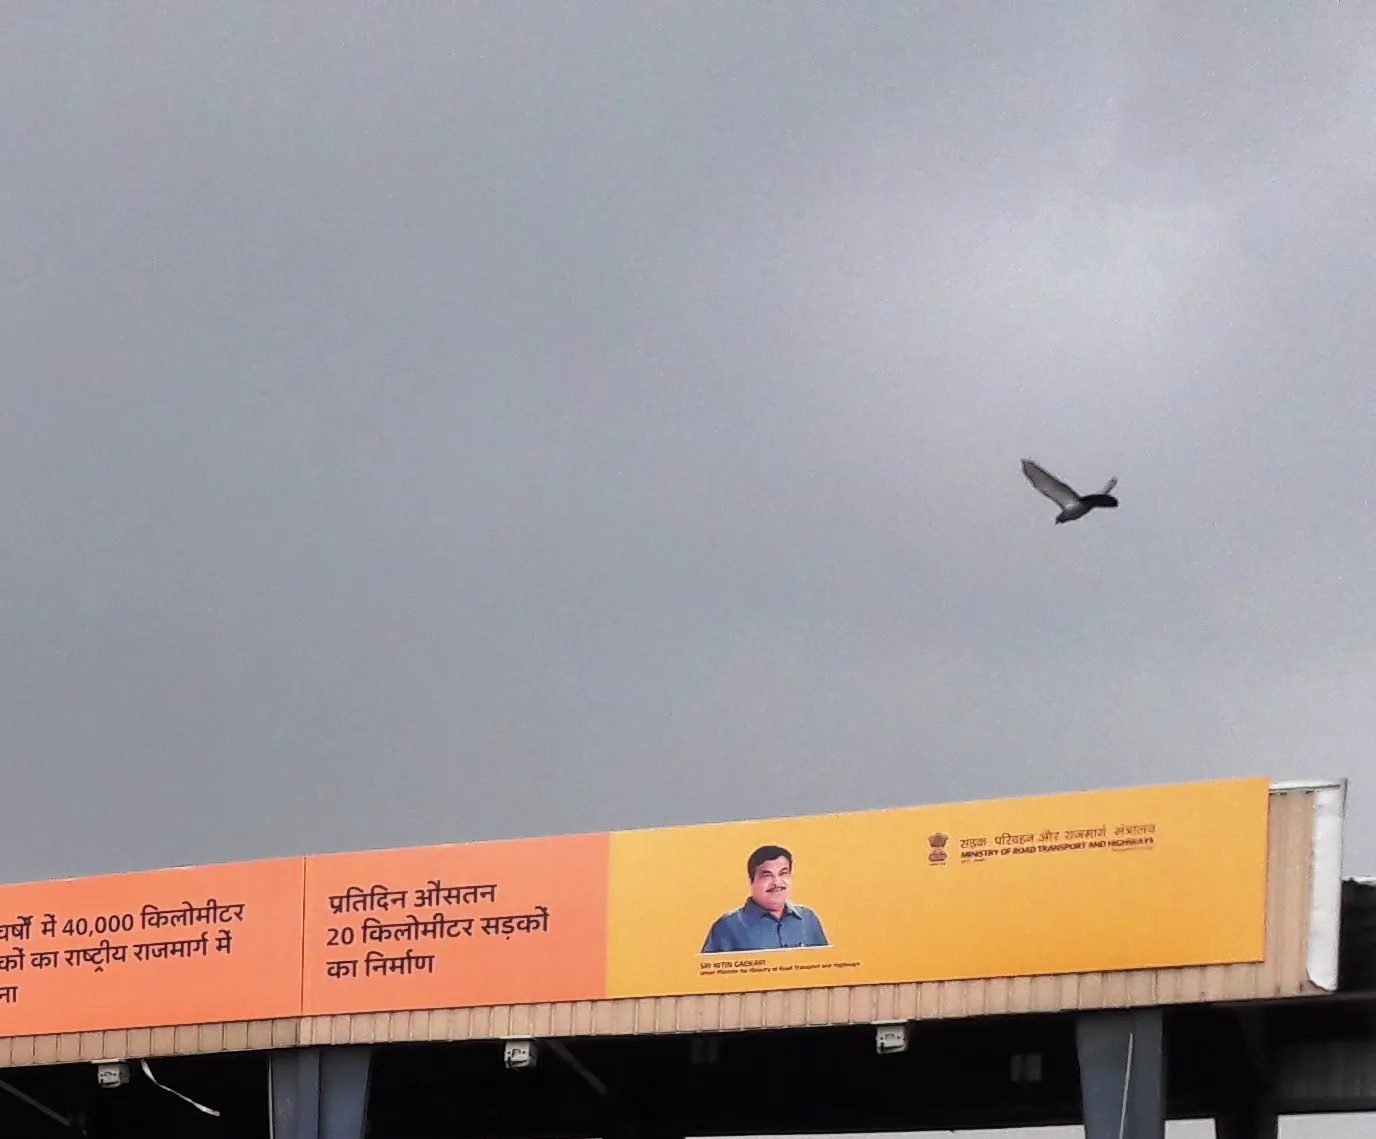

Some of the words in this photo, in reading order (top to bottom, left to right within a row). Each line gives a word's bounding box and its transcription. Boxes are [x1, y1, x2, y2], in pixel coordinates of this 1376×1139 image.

[328, 885, 408, 914] प्रतिदिन
[414, 880, 497, 908] औसतन
[41, 913, 57, 938] में
[62, 913, 134, 937] 40,000
[140, 898, 245, 930] किलोमीटर
[327, 927, 354, 946] 20
[361, 913, 474, 944] किलोमीटर
[480, 905, 550, 941] सड़कों
[30, 951, 59, 969] का
[64, 939, 128, 973] राष्ट्रीय
[133, 931, 208, 961] राजमार्ग
[215, 929, 232, 954] में
[326, 959, 358, 979] का
[364, 949, 435, 977] निर्माण
